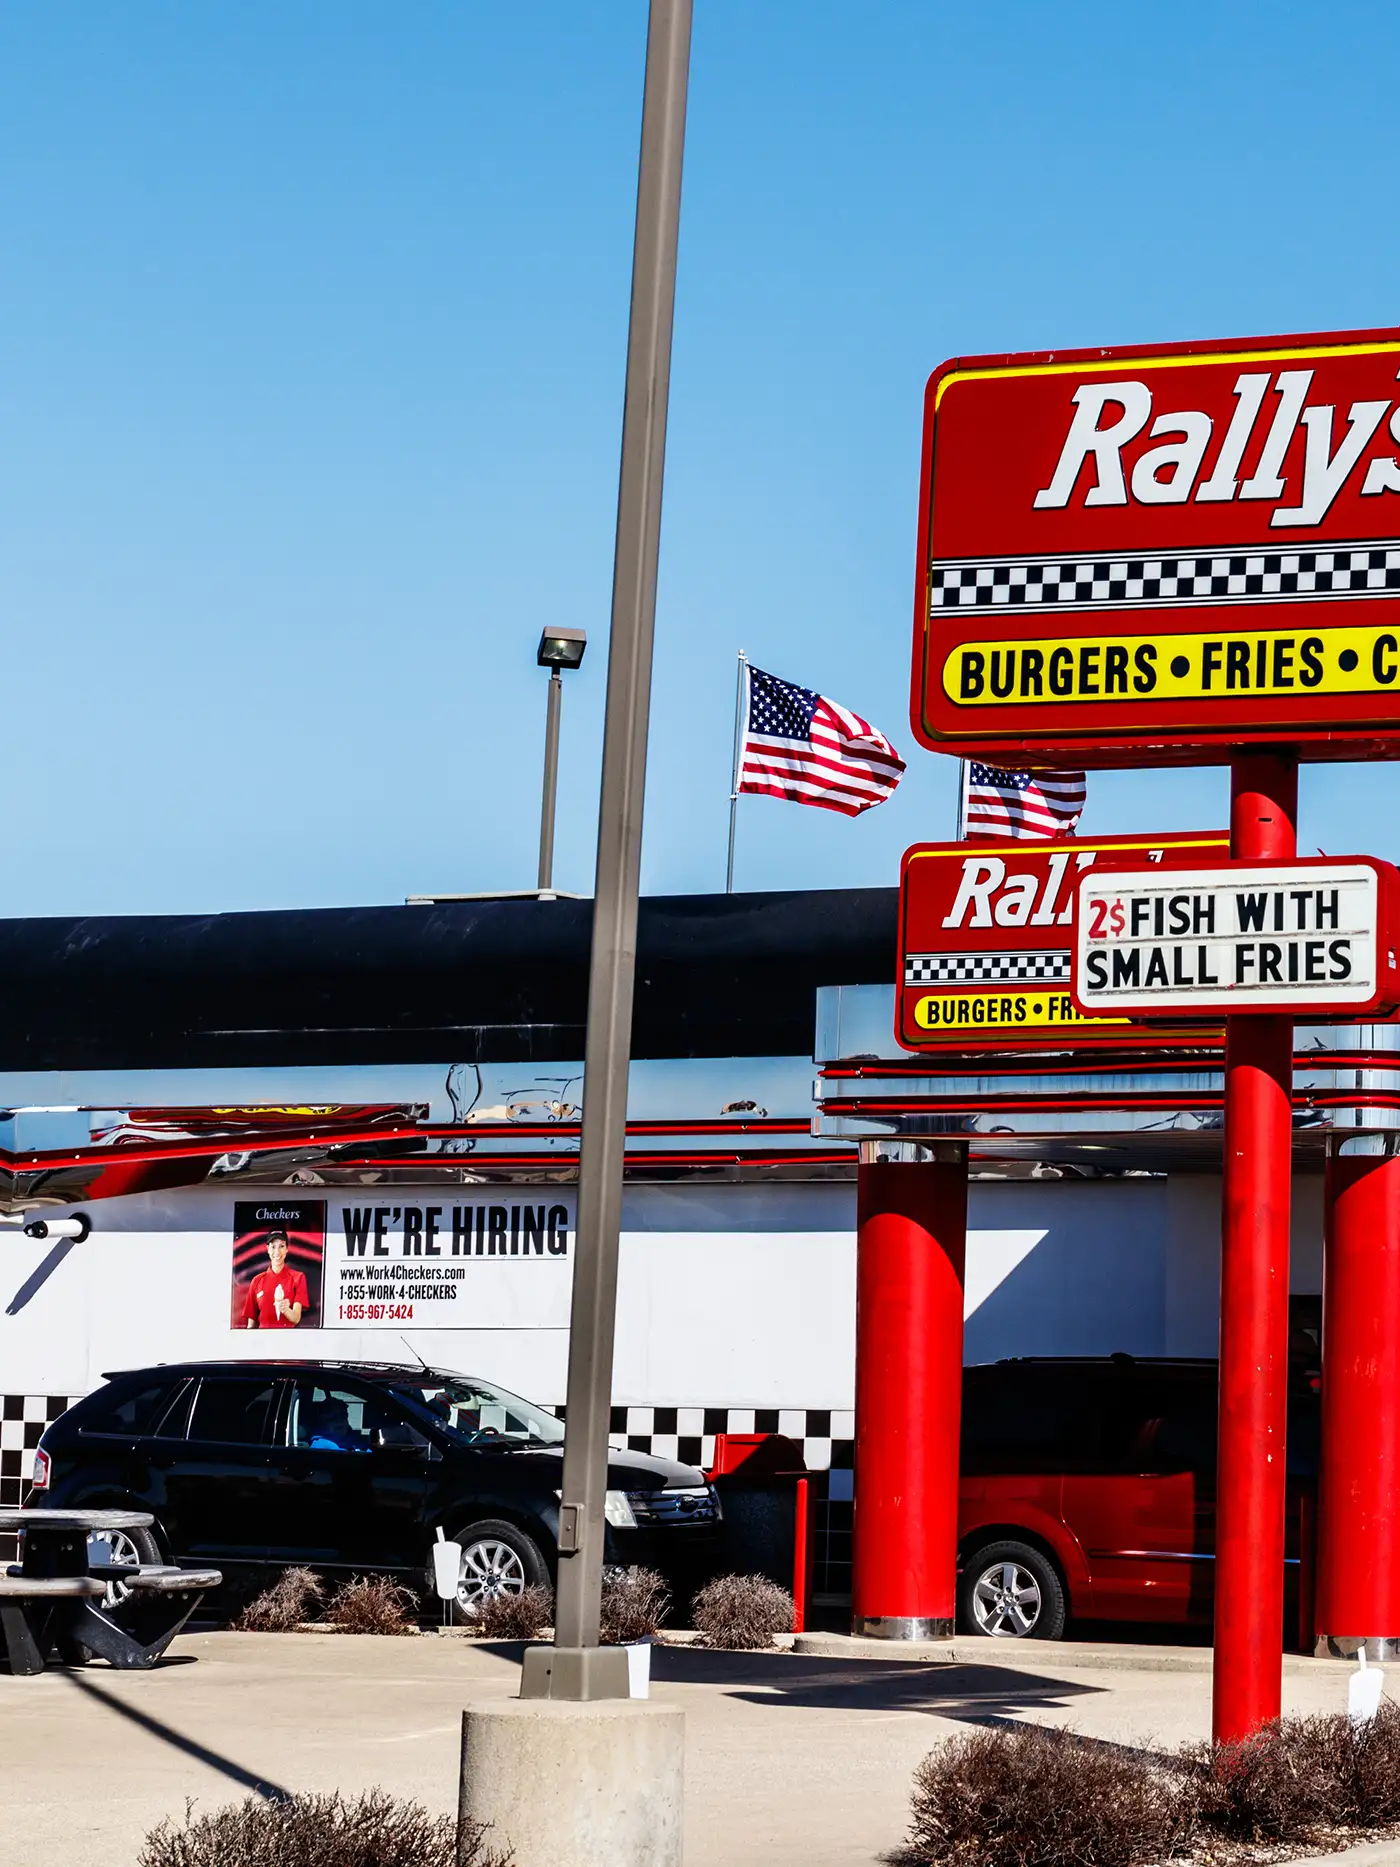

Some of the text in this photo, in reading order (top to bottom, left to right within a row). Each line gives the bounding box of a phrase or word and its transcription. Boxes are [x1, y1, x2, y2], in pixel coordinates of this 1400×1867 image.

[959, 643, 1157, 699] BURGERS
[1202, 637, 1324, 690] FRIES
[1236, 890, 1339, 932] WITH
[1086, 939, 1352, 990] SMALL FRIES
[927, 997, 1026, 1024] BURGERS
[255, 1208, 300, 1220] Checkers
[342, 1205, 568, 1257] WE'RE HIRING
[340, 1265, 465, 1282] www.Work4Checkers.com
[339, 1284, 457, 1301] 1-855-WORK-4-CHECKERS
[338, 1304, 413, 1320] 1-855-967-5424
